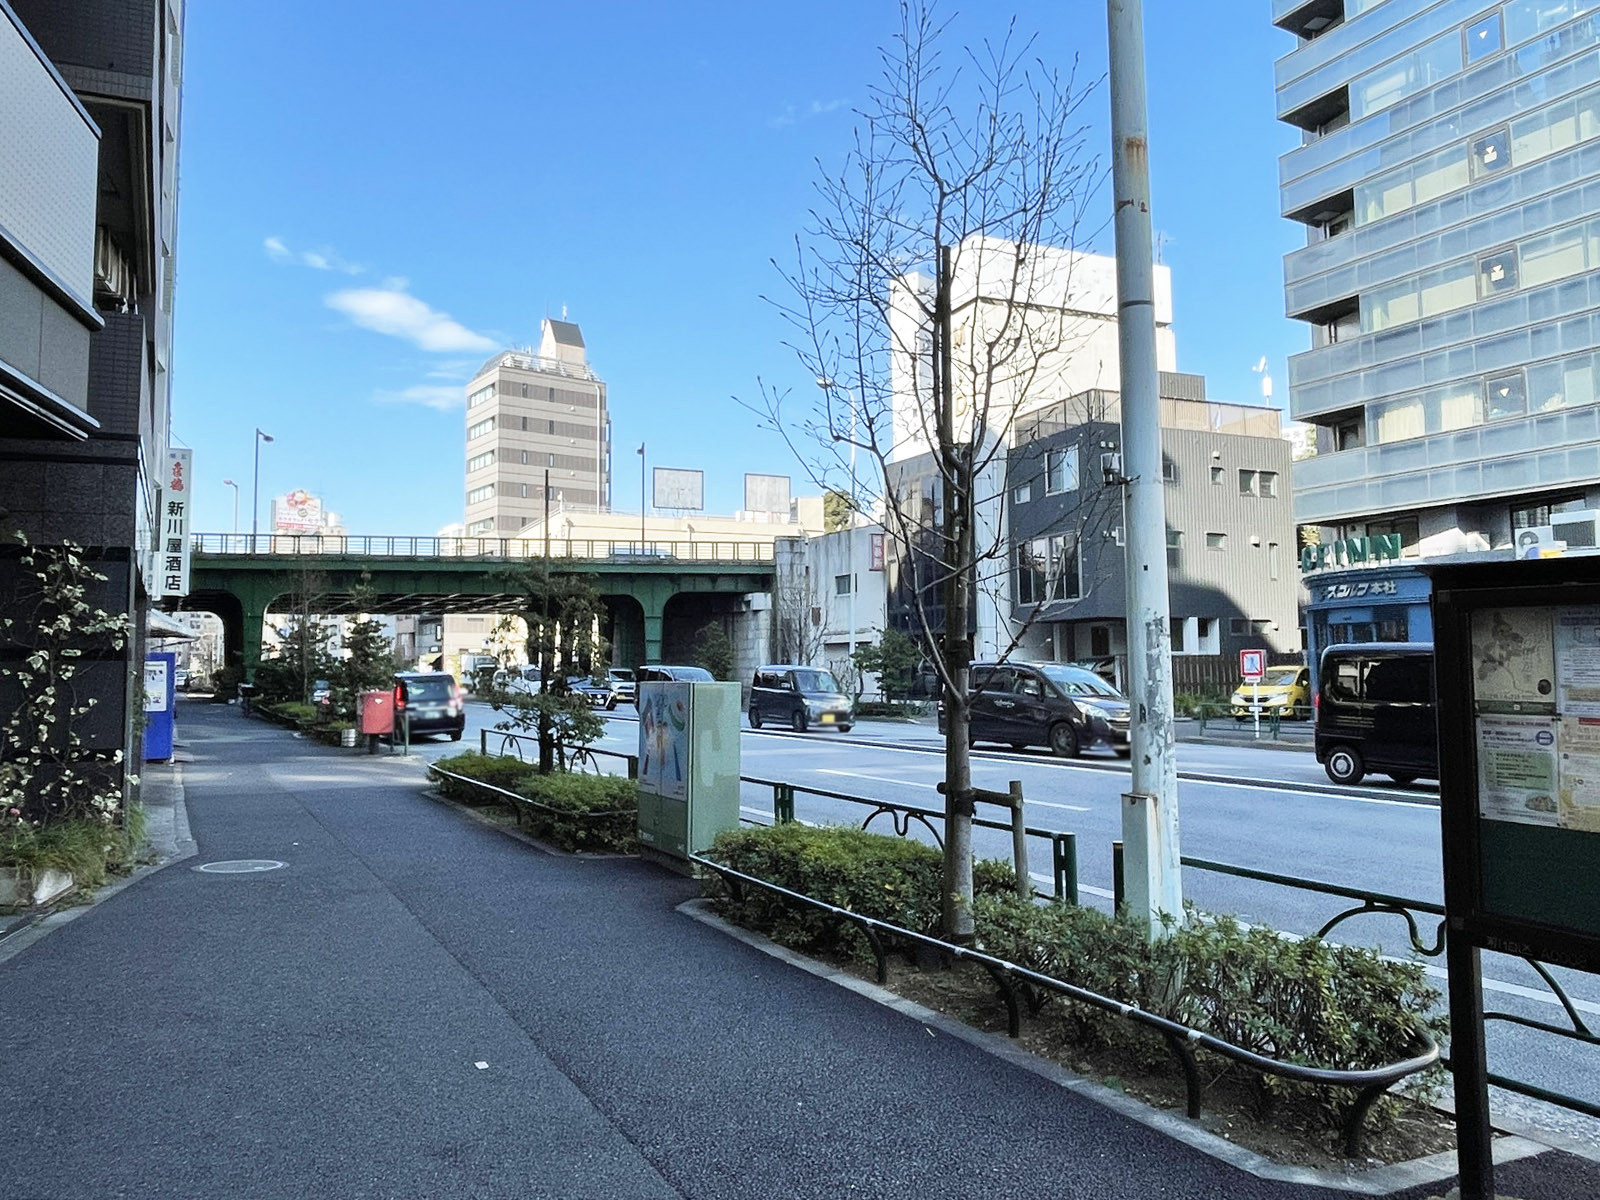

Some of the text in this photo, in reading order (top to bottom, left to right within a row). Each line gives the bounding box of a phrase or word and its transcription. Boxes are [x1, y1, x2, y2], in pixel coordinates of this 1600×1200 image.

[165, 501, 184, 591] 新川屋酒店
